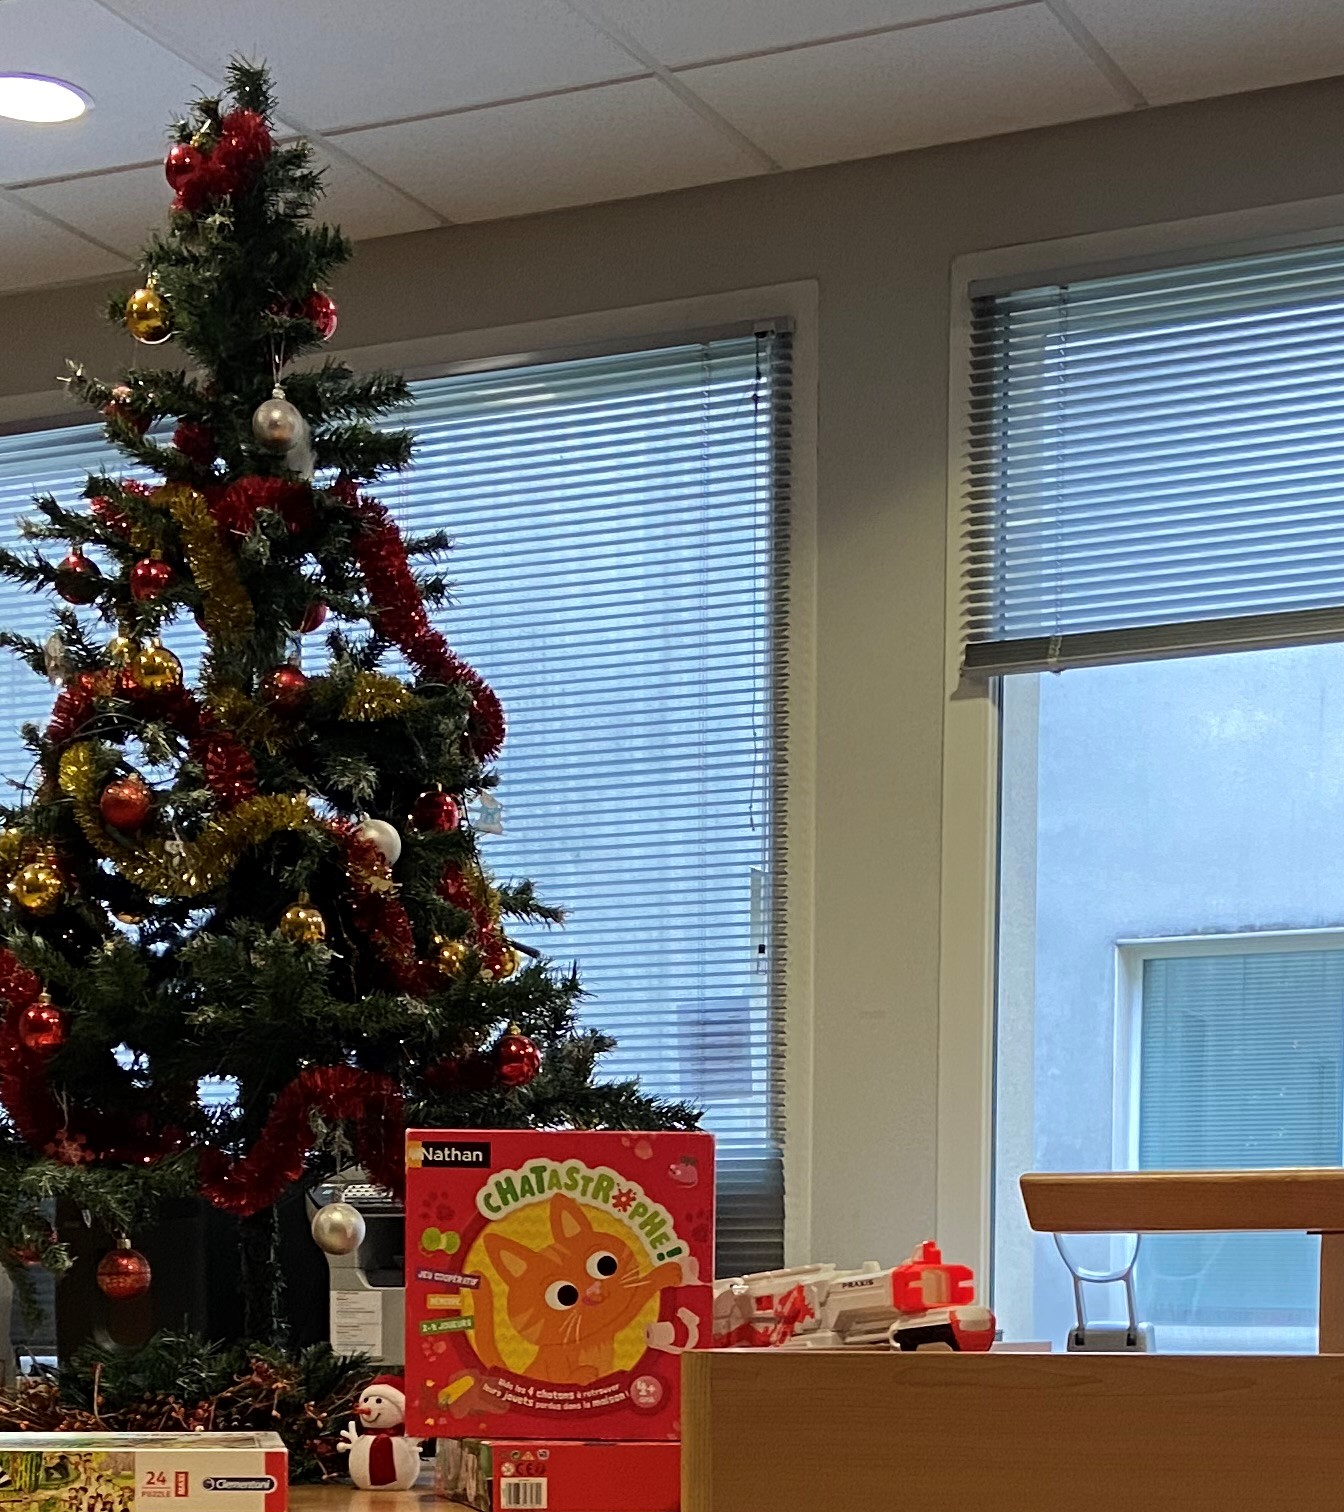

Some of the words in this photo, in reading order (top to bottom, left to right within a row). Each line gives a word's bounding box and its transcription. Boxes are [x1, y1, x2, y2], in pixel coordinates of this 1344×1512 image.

[421, 1146, 484, 1163] Nathan
[842, 1279, 874, 1289] PRAXIS
[146, 1471, 167, 1486] 24
[216, 1479, 271, 1490] Clementoni
